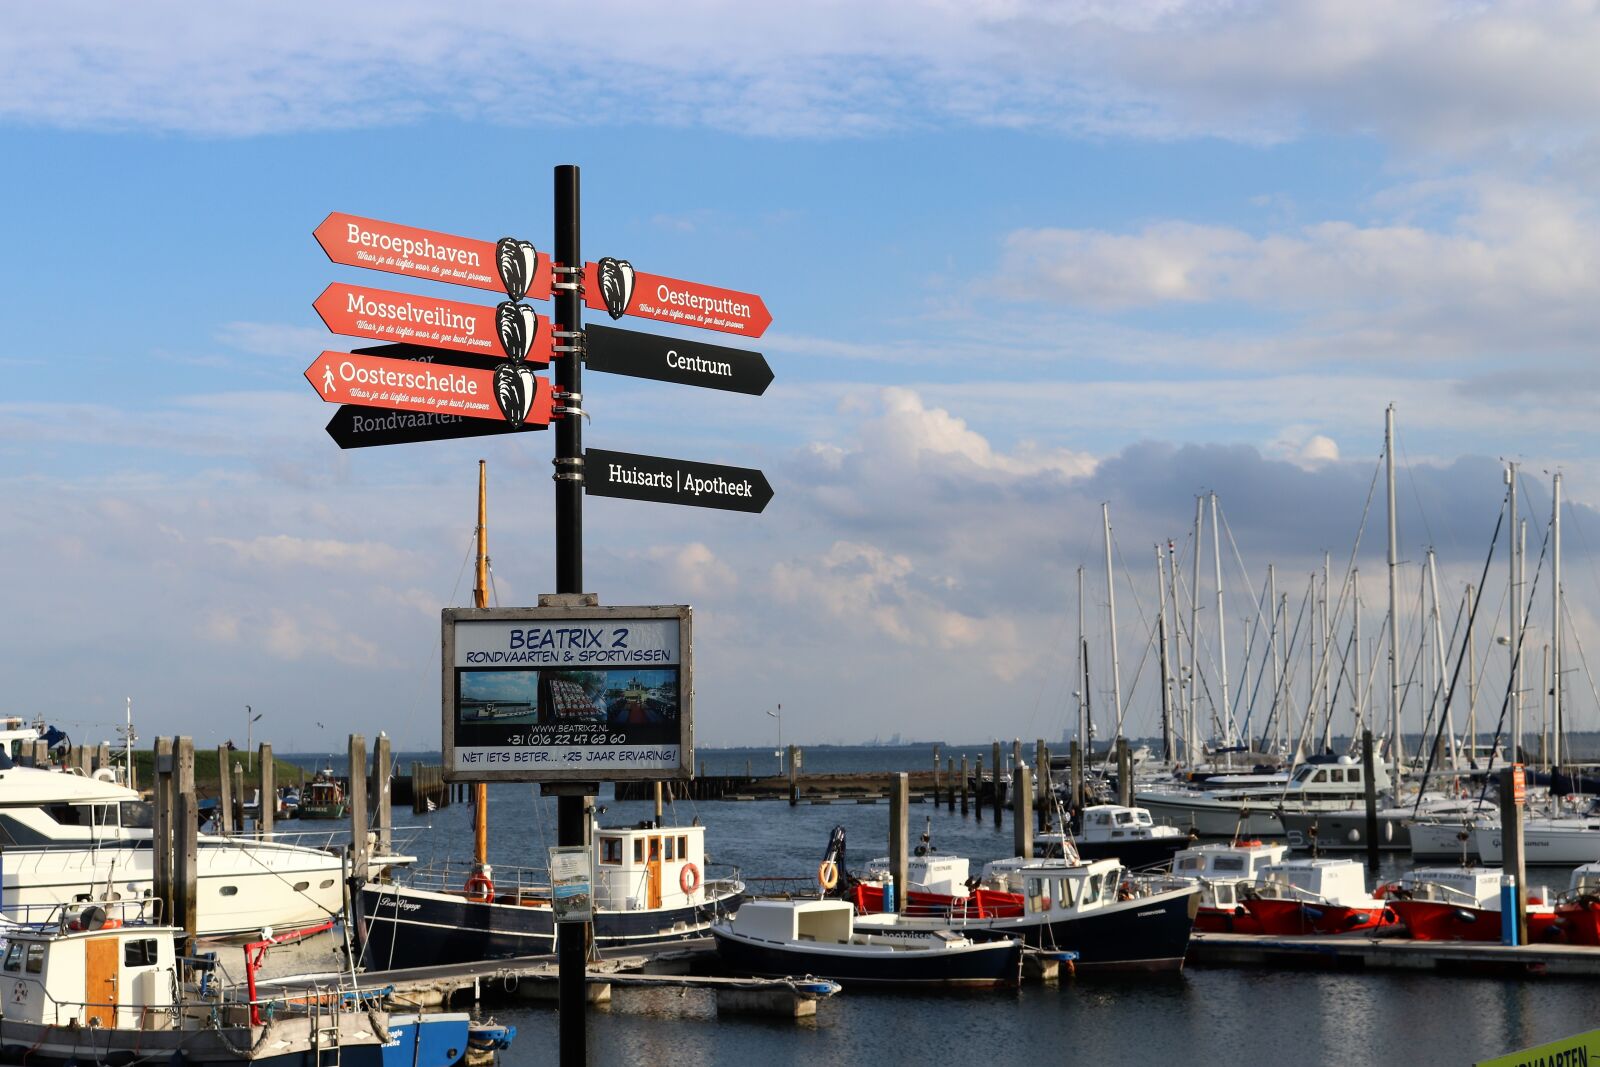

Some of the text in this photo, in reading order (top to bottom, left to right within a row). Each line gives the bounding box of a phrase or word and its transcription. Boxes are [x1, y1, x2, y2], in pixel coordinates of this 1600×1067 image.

[347, 223, 480, 267] Beroepshaven
[356, 250, 376, 262] Waar
[376, 256, 385, 265] je
[386, 256, 395, 265] de
[395, 257, 414, 270] liefde
[415, 263, 430, 272] voor
[431, 264, 440, 273] de
[452, 268, 467, 278] kunt
[467, 272, 492, 283] proeven
[347, 293, 476, 335] Mosselveiling
[657, 284, 751, 319] Oesterputten
[356, 320, 376, 331] Waar
[376, 324, 385, 334] je
[386, 324, 394, 333] de
[395, 325, 414, 338] liefde
[431, 331, 440, 340] de
[440, 335, 452, 343] zee
[452, 334, 467, 344] kunt
[467, 338, 492, 347] proeven
[666, 350, 732, 376] Centrum
[339, 361, 478, 395] Oosterschelde
[349, 387, 370, 398] Waar
[370, 391, 379, 401] je
[380, 391, 389, 400] de
[390, 391, 409, 405] liefde
[427, 396, 436, 405] de
[436, 400, 448, 408] zee
[449, 398, 464, 408] kunt
[464, 402, 490, 411] proeven
[352, 411, 462, 433] Rondvaarten
[608, 463, 673, 489] Huisarts
[684, 473, 752, 497] Apotheek
[510, 628, 629, 650] BEATRIX 2
[466, 649, 671, 663] RONDVAARTEN & SPORTVISSEN
[507, 733, 626, 746] +31 (0)6 22 47 69 60
[531, 724, 609, 733] WWW.BEATRIX2.NL
[462, 750, 676, 763] NET IETS BETER... +25 JAAR ERVARING!
